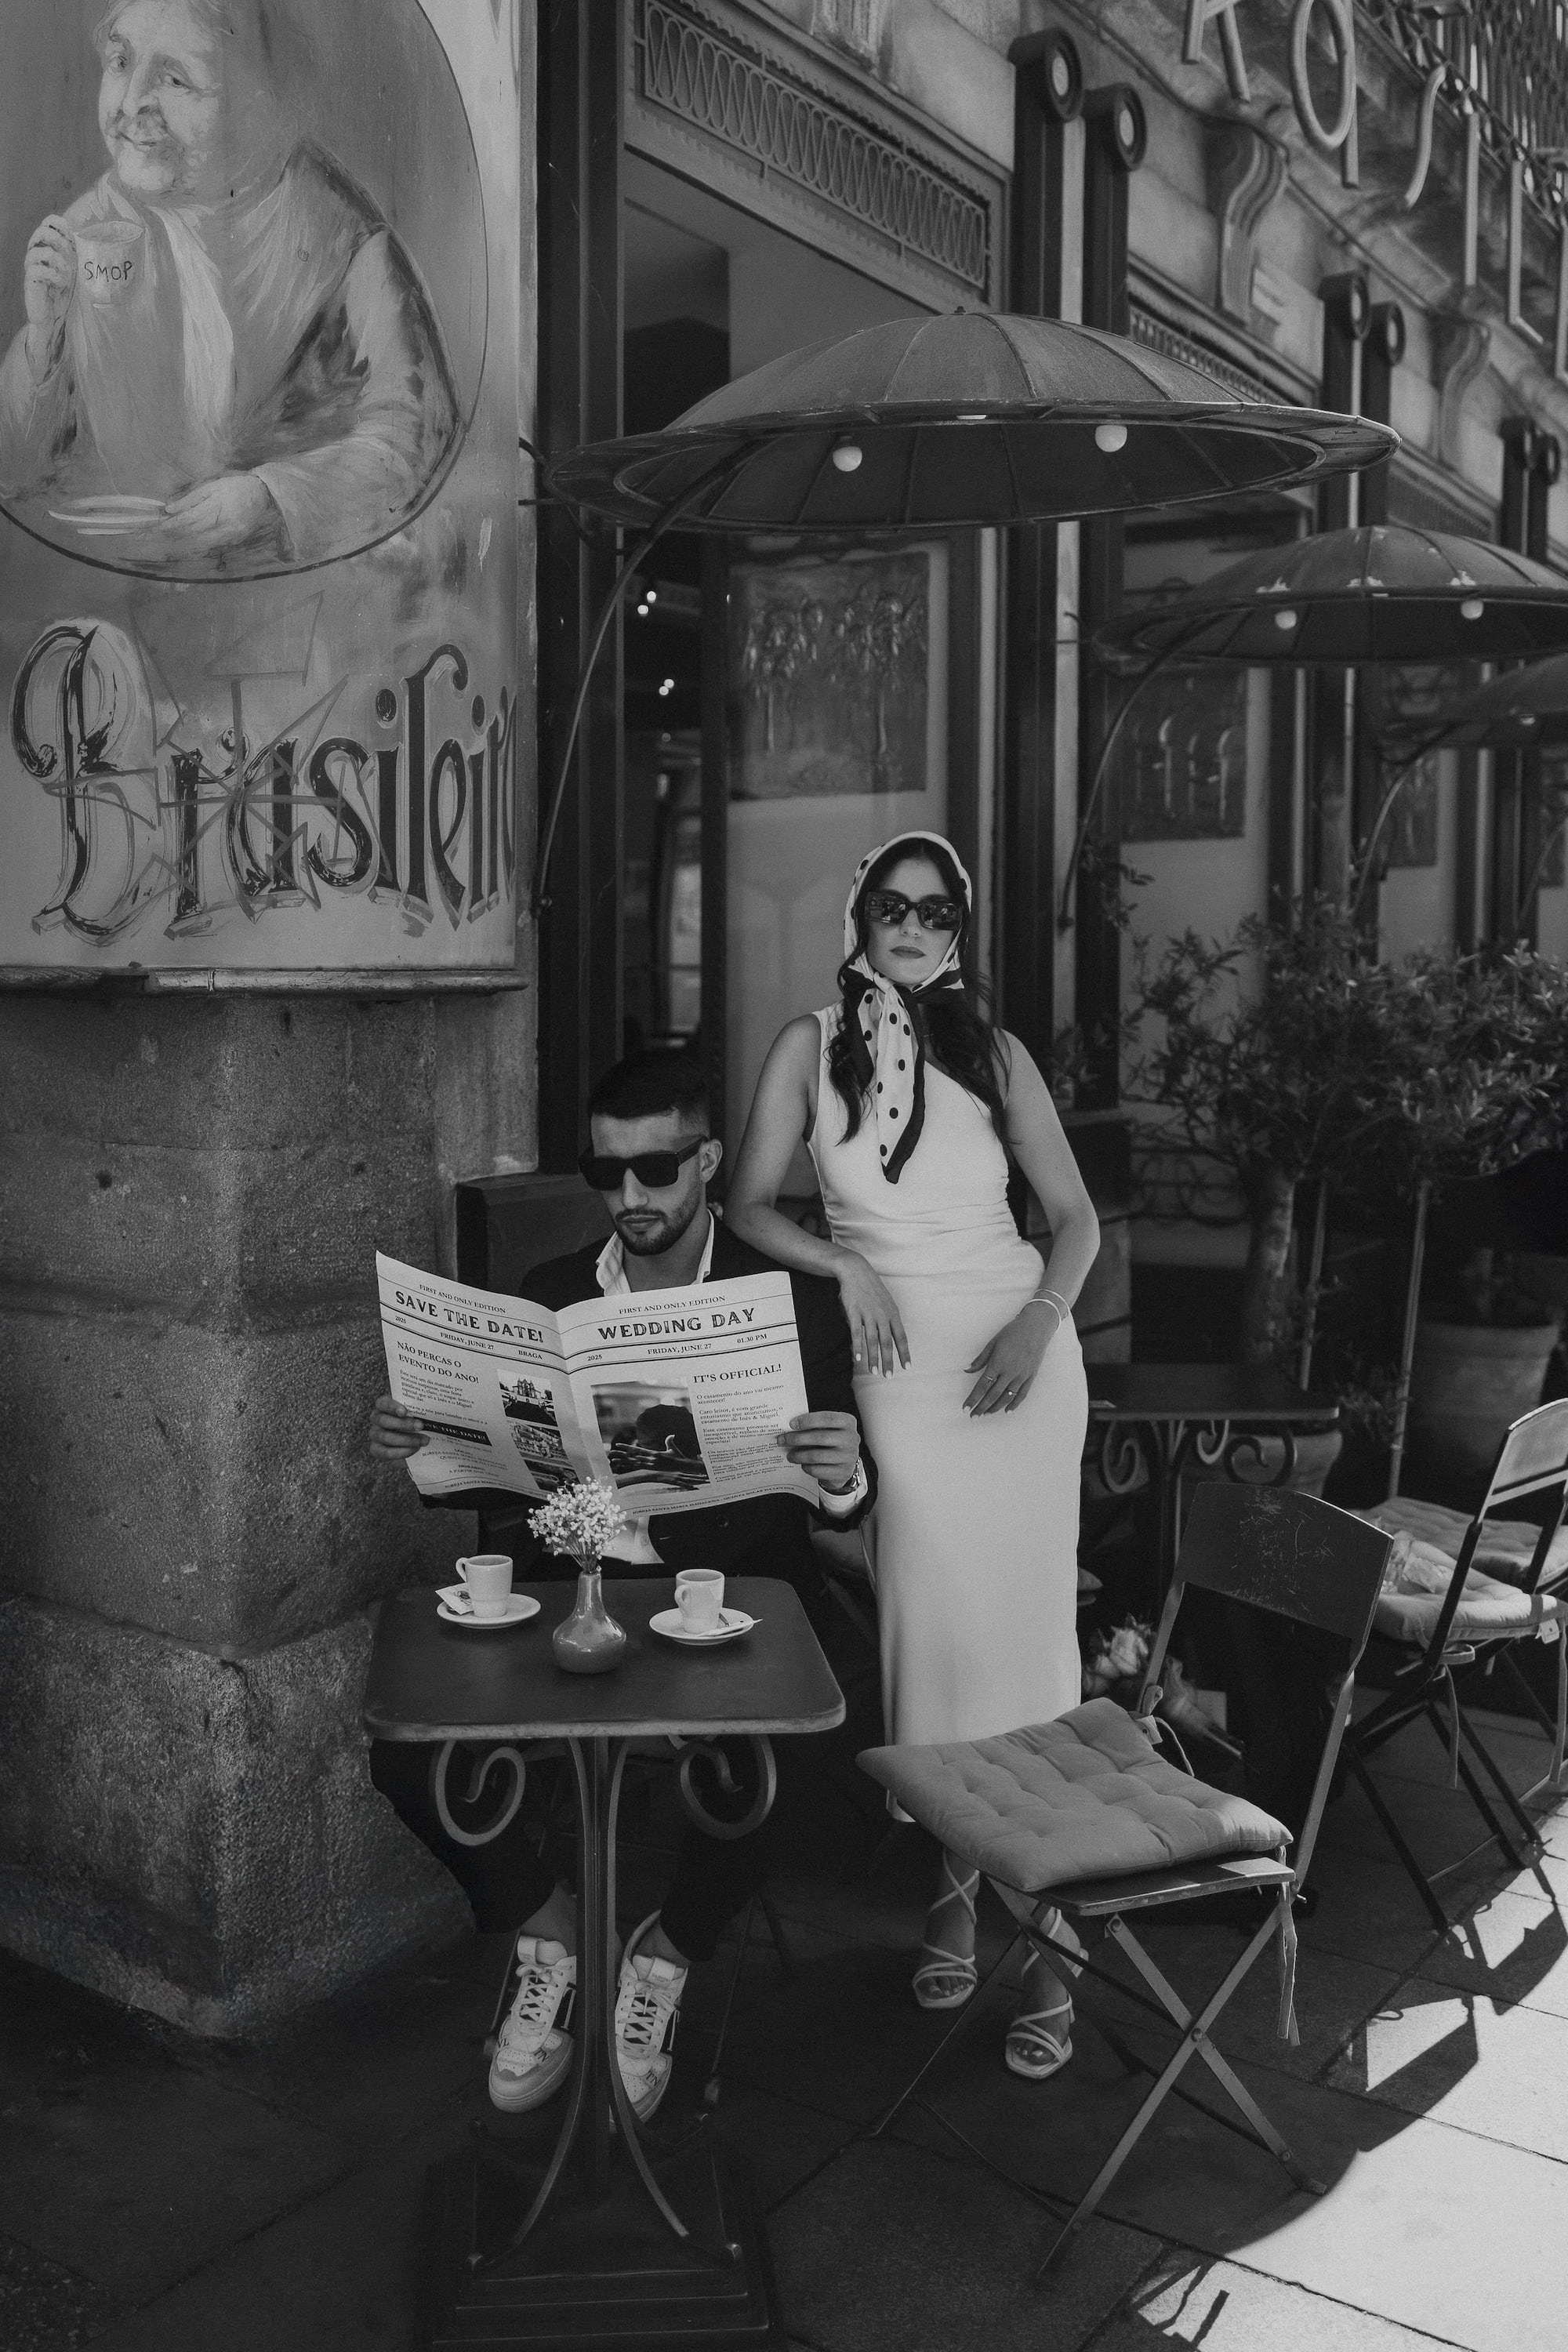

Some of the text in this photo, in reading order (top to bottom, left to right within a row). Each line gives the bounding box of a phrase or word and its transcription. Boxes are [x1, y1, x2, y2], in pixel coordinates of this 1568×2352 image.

[84, 260, 132, 282] SMOP
[419, 1284, 506, 1313] FIRST AND ONLY EDITION
[619, 1306, 642, 1315] FIRST
[663, 1301, 688, 1310] ONLY
[689, 1295, 726, 1306] EDITION
[395, 1290, 543, 1343] SAVE THE DATE!
[395, 1316, 407, 1324] 2025
[597, 1308, 754, 1340] WEDDING DAY
[441, 1332, 467, 1345] FRIDAY,
[467, 1340, 486, 1348] JUNE
[681, 1344, 702, 1353] JUNE
[397, 1341, 416, 1354] NÃO
[418, 1349, 452, 1366] PERCAS
[518, 1350, 543, 1359] BRAGA
[398, 1354, 479, 1384] EVENTO DO ANO!
[693, 1363, 782, 1384] IT'S OFFICIAL!
[497, 2038, 510, 2049] VL
[533, 2047, 550, 2063] TN
[646, 2070, 659, 2087] TN
